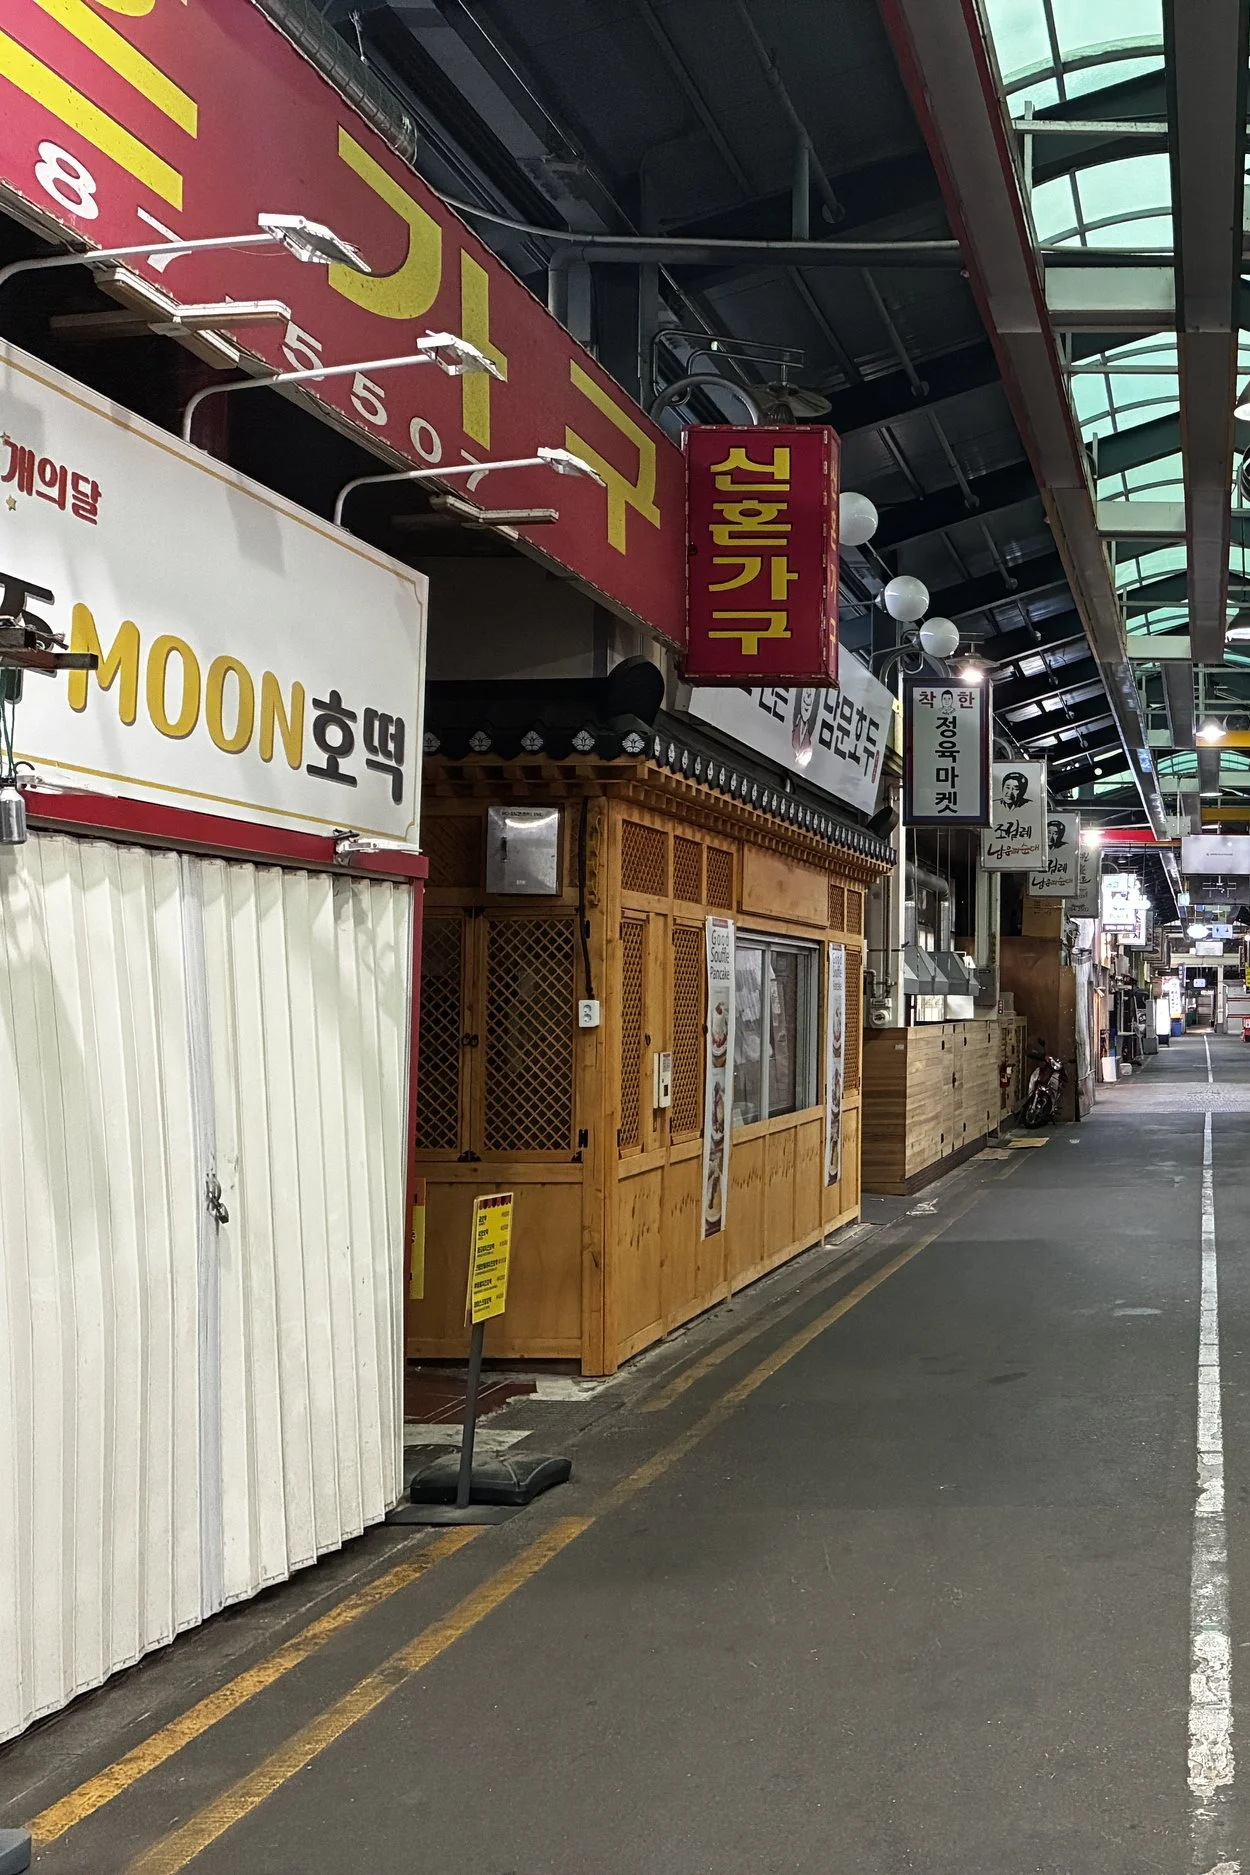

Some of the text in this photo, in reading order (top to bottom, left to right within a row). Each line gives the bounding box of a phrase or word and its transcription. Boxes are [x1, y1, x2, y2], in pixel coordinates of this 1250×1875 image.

[708, 447, 799, 656] 신혼가구
[819, 688, 881, 777] 남문호두
[935, 716, 960, 814] 정육마켓
[1038, 858, 1068, 875] 점례
[711, 930, 730, 946] Good
